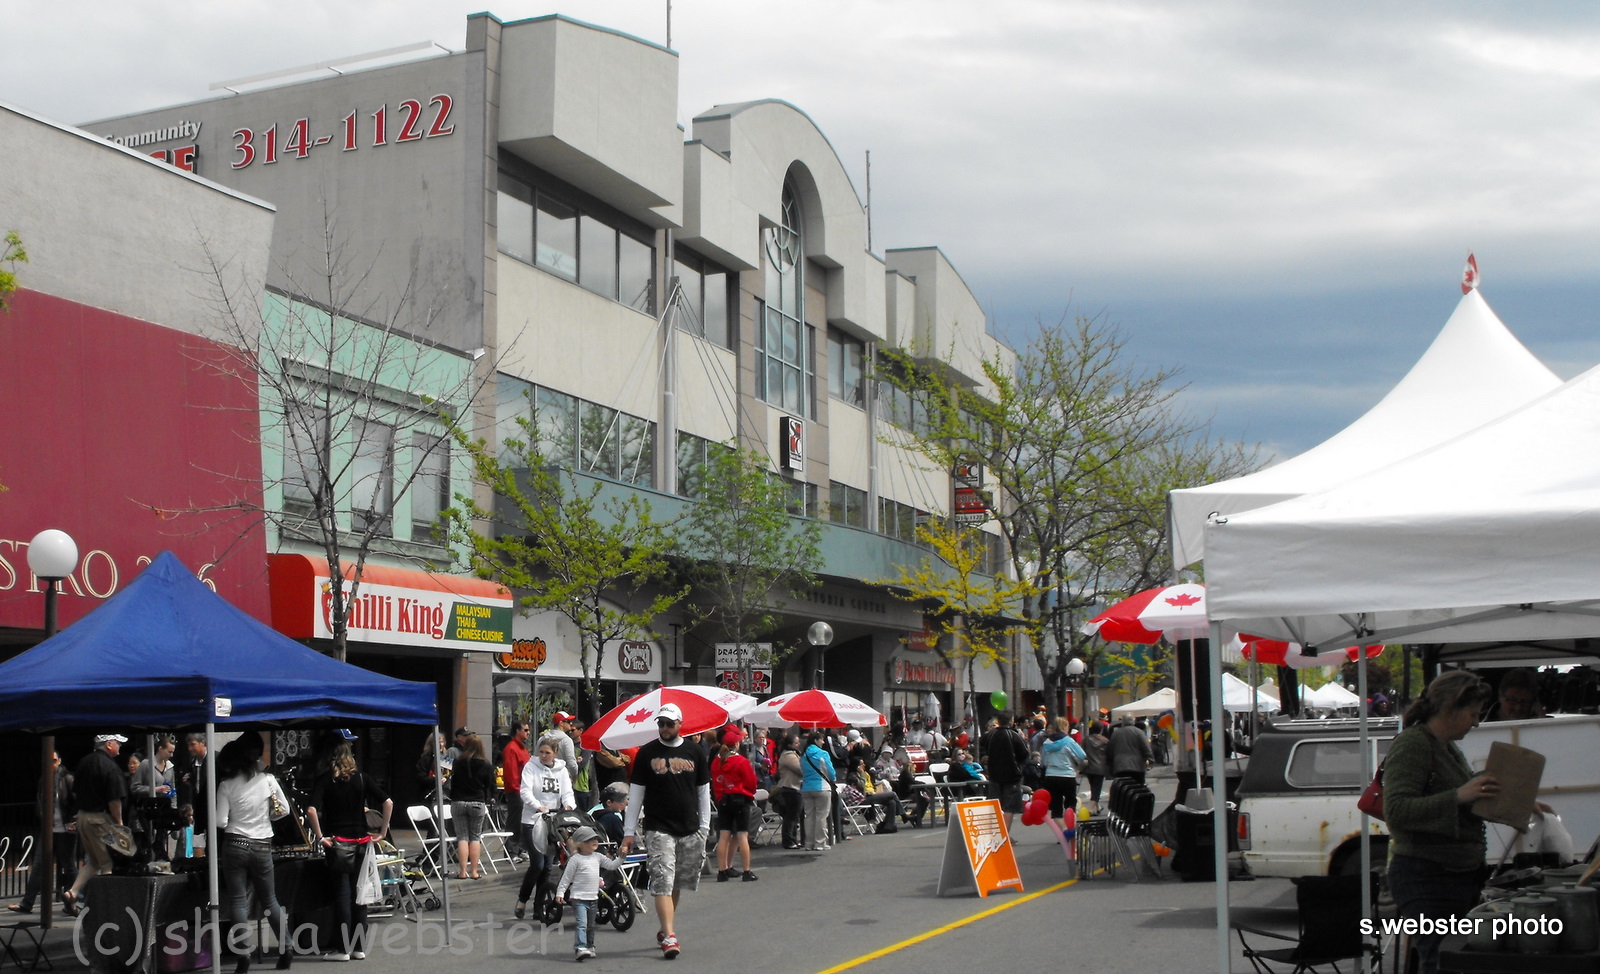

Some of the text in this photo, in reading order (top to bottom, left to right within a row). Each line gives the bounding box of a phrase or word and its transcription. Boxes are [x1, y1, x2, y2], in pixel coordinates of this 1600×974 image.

[231, 94, 454, 169] 314-1122
[456, 604, 491, 618] MALAYSIAN
[397, 597, 444, 640] King
[456, 616, 471, 627] THAI
[456, 628, 504, 642] CHINESE CUISINE
